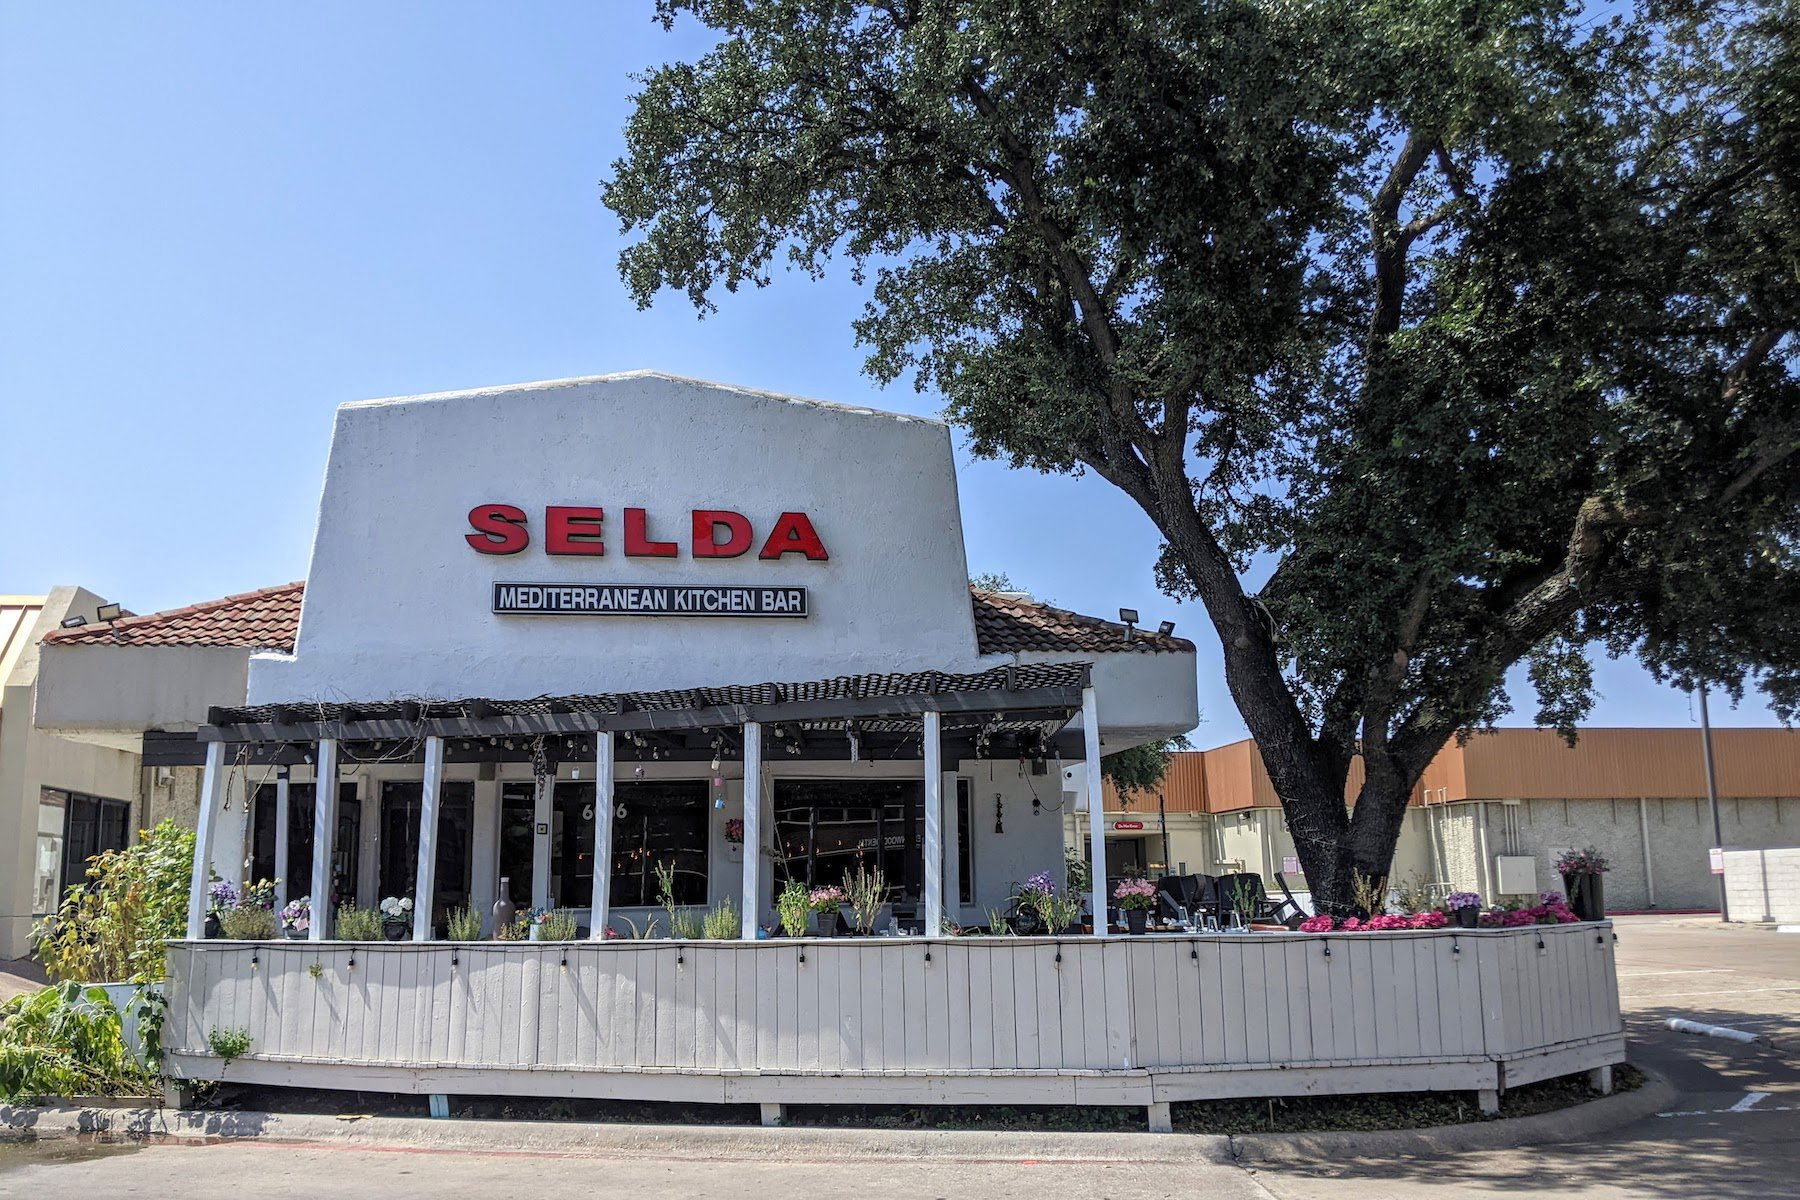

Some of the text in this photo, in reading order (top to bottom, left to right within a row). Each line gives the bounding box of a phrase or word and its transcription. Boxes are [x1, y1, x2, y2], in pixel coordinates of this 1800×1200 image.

[464, 503, 829, 561] SELDA
[499, 586, 802, 612] MEDITERRANEAN KITCHEN BAR
